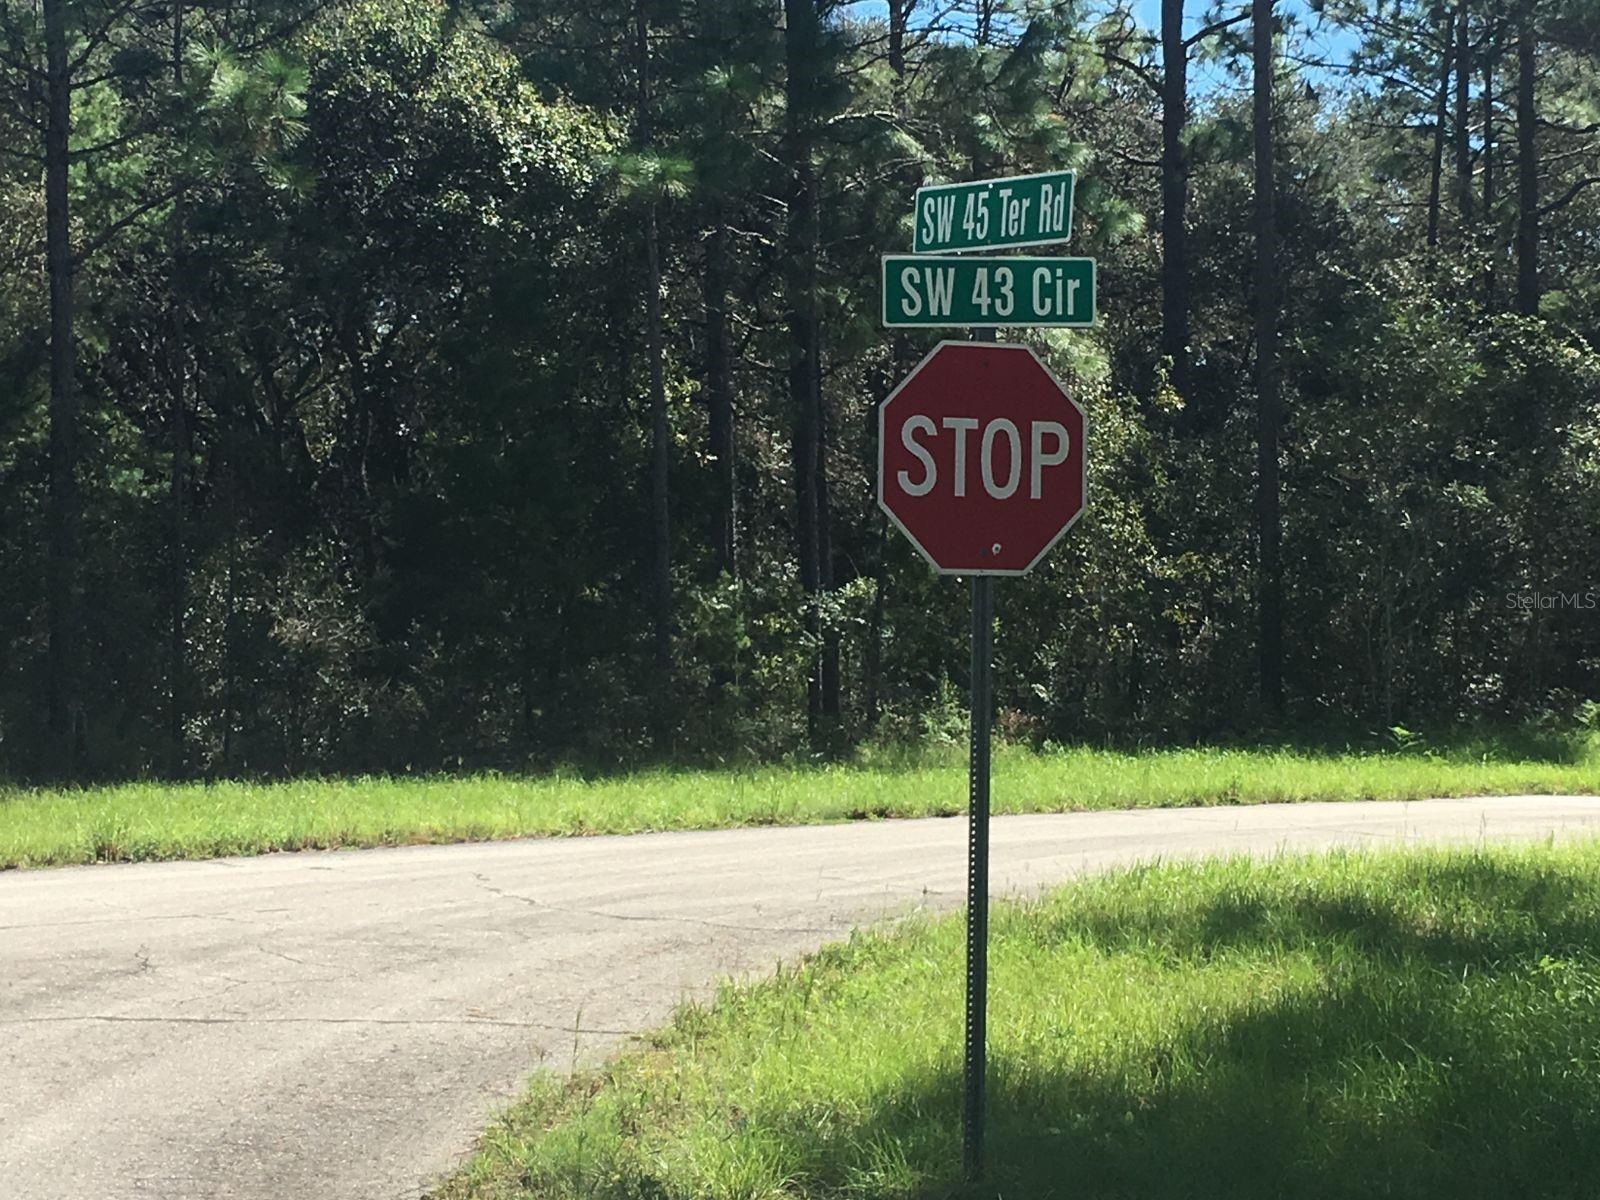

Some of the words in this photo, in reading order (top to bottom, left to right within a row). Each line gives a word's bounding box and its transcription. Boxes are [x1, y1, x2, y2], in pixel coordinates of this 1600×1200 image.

[922, 195, 956, 245] SW
[962, 191, 990, 241] 45
[999, 188, 1030, 237] Ter
[1038, 182, 1066, 234] Rd
[900, 266, 956, 317] SW
[972, 266, 1015, 317] 43
[1032, 266, 1081, 317] Cir
[897, 414, 1070, 500] STOP
